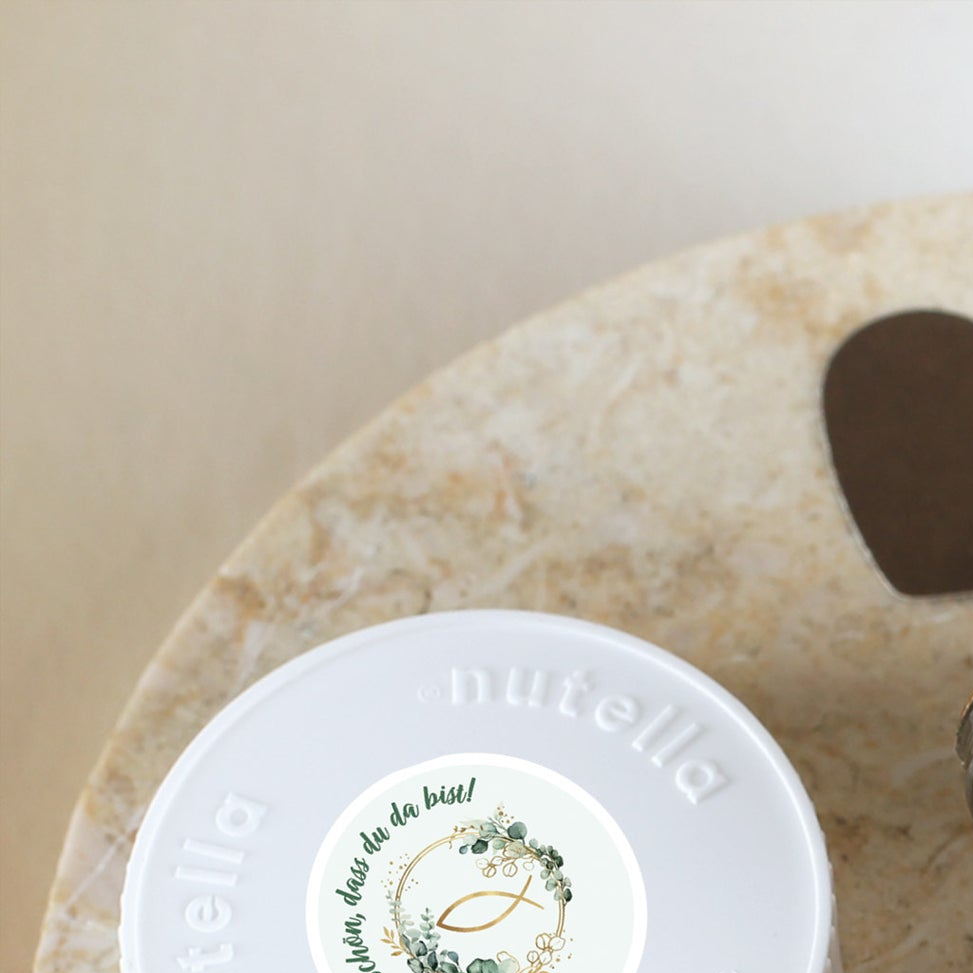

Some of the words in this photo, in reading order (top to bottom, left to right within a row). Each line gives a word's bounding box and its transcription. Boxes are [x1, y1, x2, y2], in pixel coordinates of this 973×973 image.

[449, 664, 729, 804] nutella
[335, 857, 370, 906] dass
[359, 826, 390, 855] du
[389, 802, 419, 827] da
[423, 777, 476, 810] bist!
